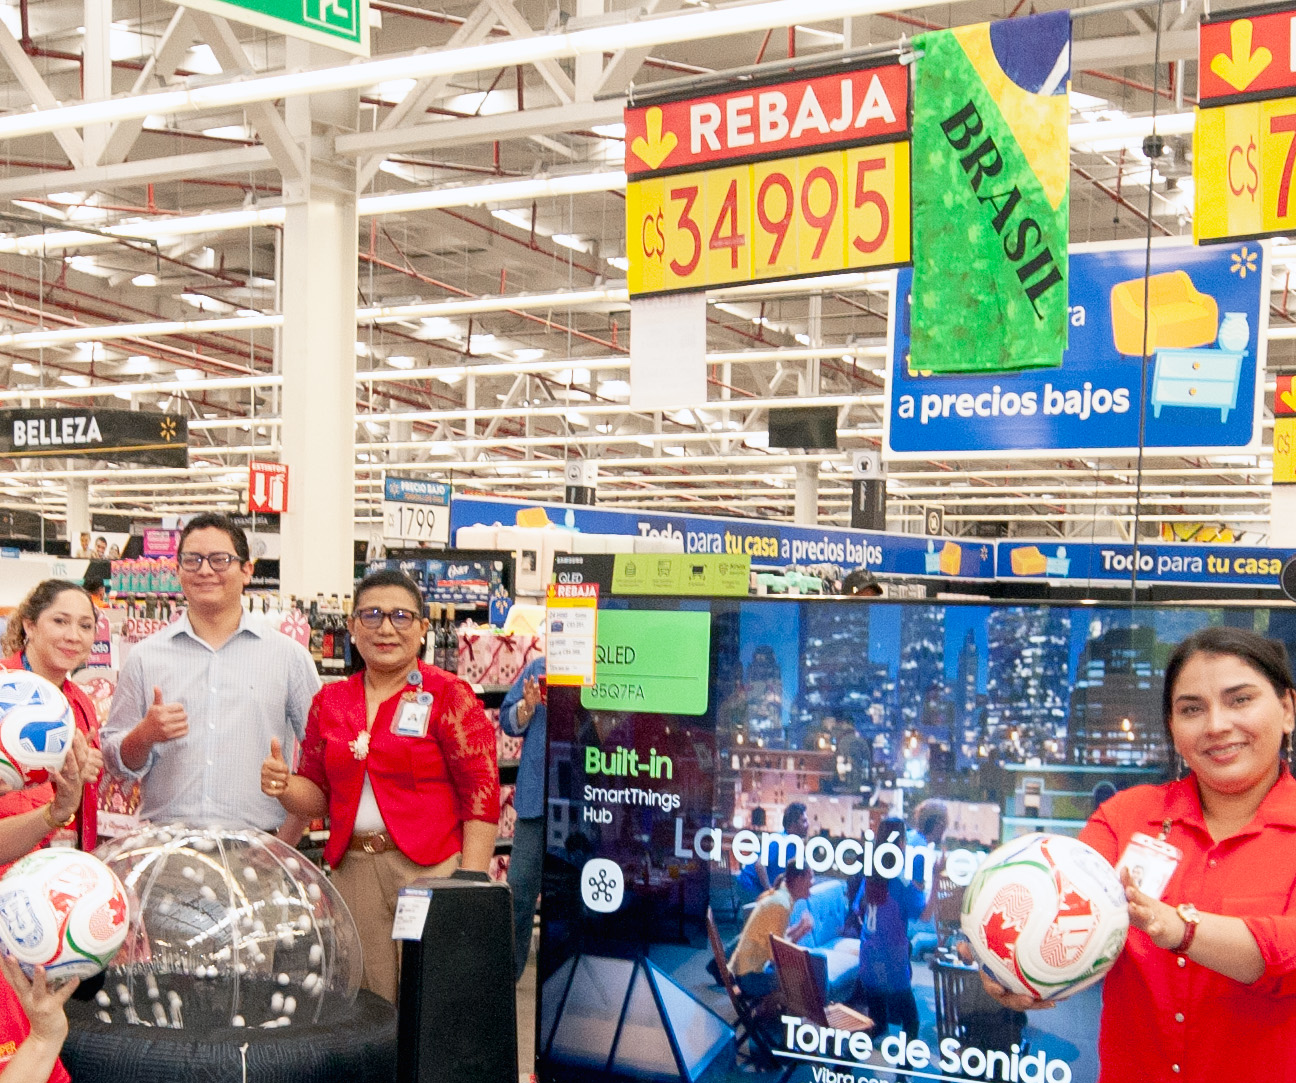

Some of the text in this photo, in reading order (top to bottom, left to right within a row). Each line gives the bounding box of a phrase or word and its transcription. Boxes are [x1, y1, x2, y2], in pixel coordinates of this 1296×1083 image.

[689, 74, 897, 154] REBAJA
[669, 157, 890, 278] 34995
[940, 100, 1065, 321] BRASIL
[898, 381, 1131, 424] a precios bajos
[13, 416, 103, 447] BELLEZA
[427, 483, 446, 496] BAJO
[398, 506, 436, 537] 1799
[687, 533, 722, 554] para
[725, 532, 743, 554] tu
[744, 536, 779, 558] casa
[781, 540, 791, 558] a
[792, 537, 846, 563] precios
[847, 540, 883, 565] bajos
[558, 571, 584, 585] QLED
[1157, 554, 1202, 576] para
[1206, 553, 1231, 574] tu
[1233, 555, 1282, 576] casa
[557, 585, 597, 597] REBAJA
[595, 645, 636, 665] QLED
[584, 745, 673, 780] Built-in
[583, 784, 681, 814] SmartThings
[583, 806, 612, 824] Hub
[674, 816, 991, 887] La emoción e
[781, 1015, 873, 1061] Torre
[881, 1031, 931, 1068] de
